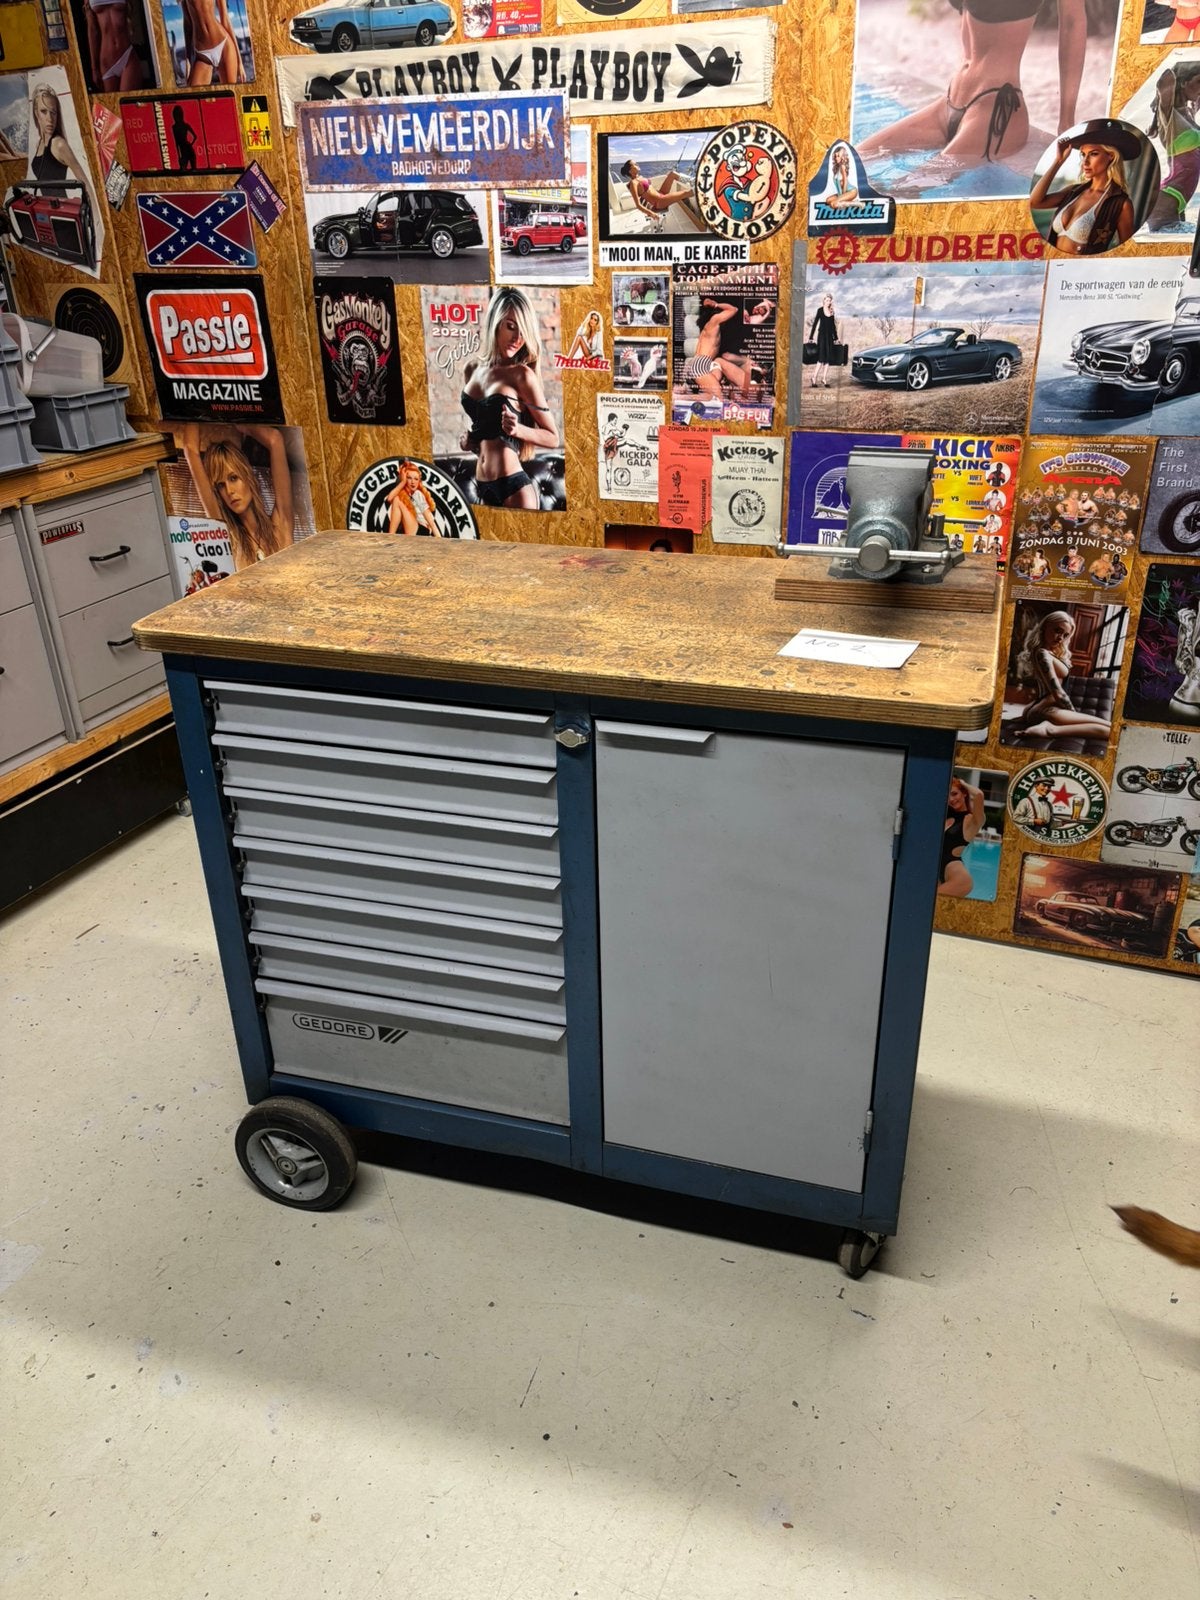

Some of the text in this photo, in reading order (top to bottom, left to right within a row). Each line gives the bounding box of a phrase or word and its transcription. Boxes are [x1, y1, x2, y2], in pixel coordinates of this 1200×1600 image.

[356, 46, 672, 103] PLAYBOY PLAYBOY
[126, 118, 143, 129] RED
[309, 107, 556, 157] NIEUWEMEERDIJK
[132, 132, 159, 144] LIGHT
[154, 101, 171, 170] AMSTERDAM
[196, 143, 238, 156] DISTRICT
[707, 125, 793, 171] POPEYE
[392, 158, 472, 176] BADHOEVEDORP
[706, 204, 780, 239] SALOR
[684, 245, 701, 261] DE
[704, 244, 747, 260] KARRE
[865, 232, 1044, 263] ZUIDBERG
[677, 274, 777, 285] TOURNAMENT
[1060, 278, 1184, 293] De sportwagen van de eeuw
[430, 303, 482, 325] HOT
[159, 300, 251, 356] Passie
[336, 320, 379, 343] Garage
[432, 326, 467, 338] 2020
[436, 329, 481, 379] Girls
[173, 381, 263, 402] MAGAZINE
[600, 396, 663, 405] PROGRAMMA
[619, 450, 659, 460] KICKBOX
[717, 446, 779, 464] KICKBOX
[933, 438, 994, 458] KICK
[1163, 446, 1185, 458] The
[626, 458, 652, 467] GALA
[729, 466, 767, 475] MUAY THAI
[1054, 465, 1113, 475] AMSTERDAM
[1066, 452, 1129, 476] SHOWTIME
[1159, 461, 1188, 473] First
[1156, 476, 1194, 488] Brand
[350, 463, 399, 527] BIGGER
[417, 465, 472, 533] SPARK
[1019, 536, 1129, 556] ZONDAG 8 JUNI 2003
[1051, 823, 1088, 839] BIER
[299, 1016, 367, 1037] GEDORE
